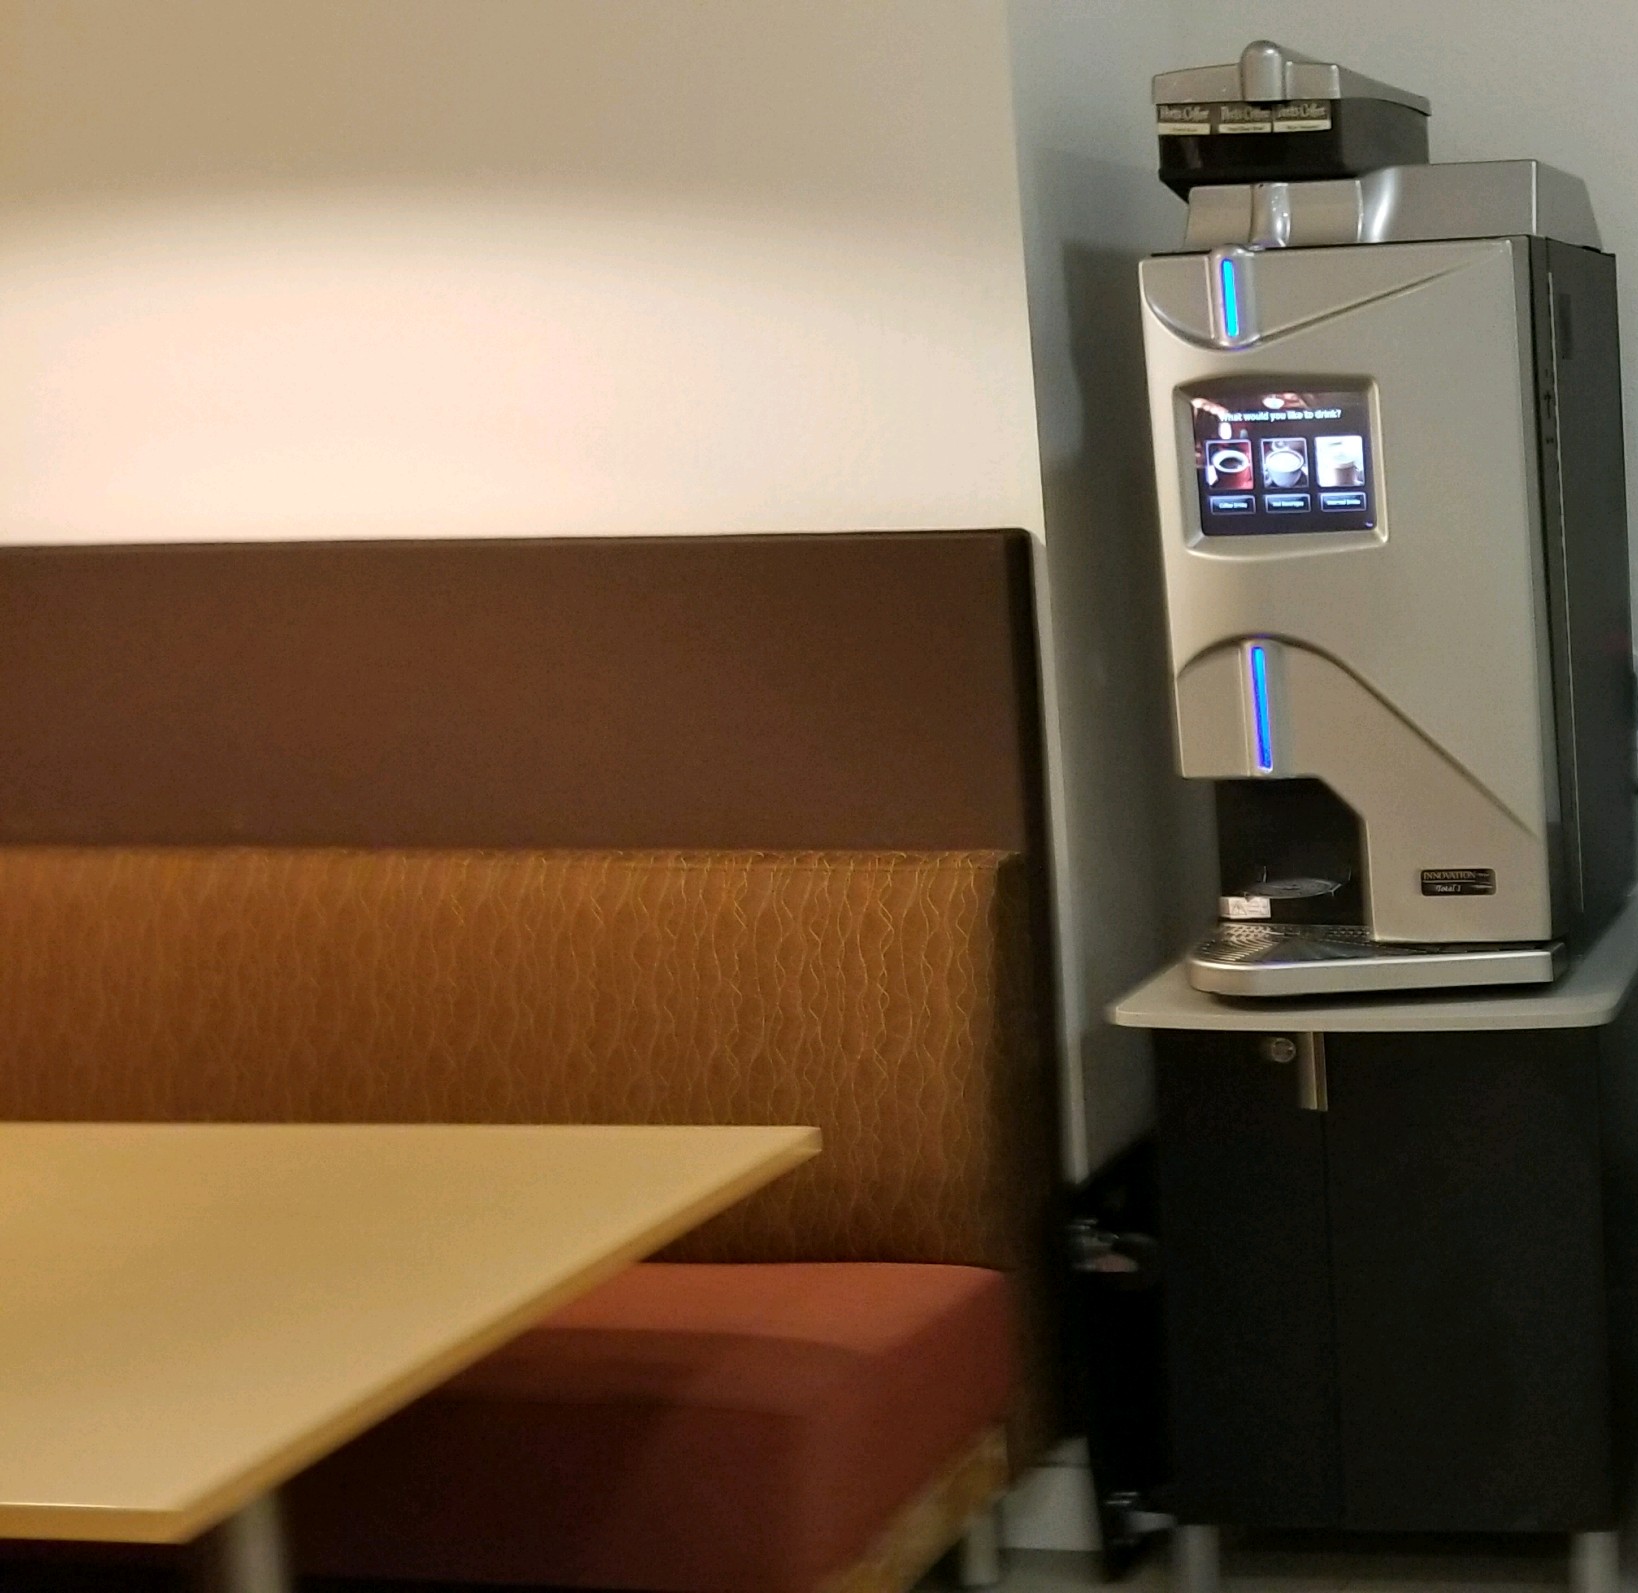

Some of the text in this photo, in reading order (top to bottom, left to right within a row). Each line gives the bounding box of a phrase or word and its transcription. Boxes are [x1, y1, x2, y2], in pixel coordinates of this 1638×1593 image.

[1221, 409, 1341, 422] What would you like to drink?
[1423, 871, 1476, 880] INNOVATION
[1436, 884, 1457, 892] Total
